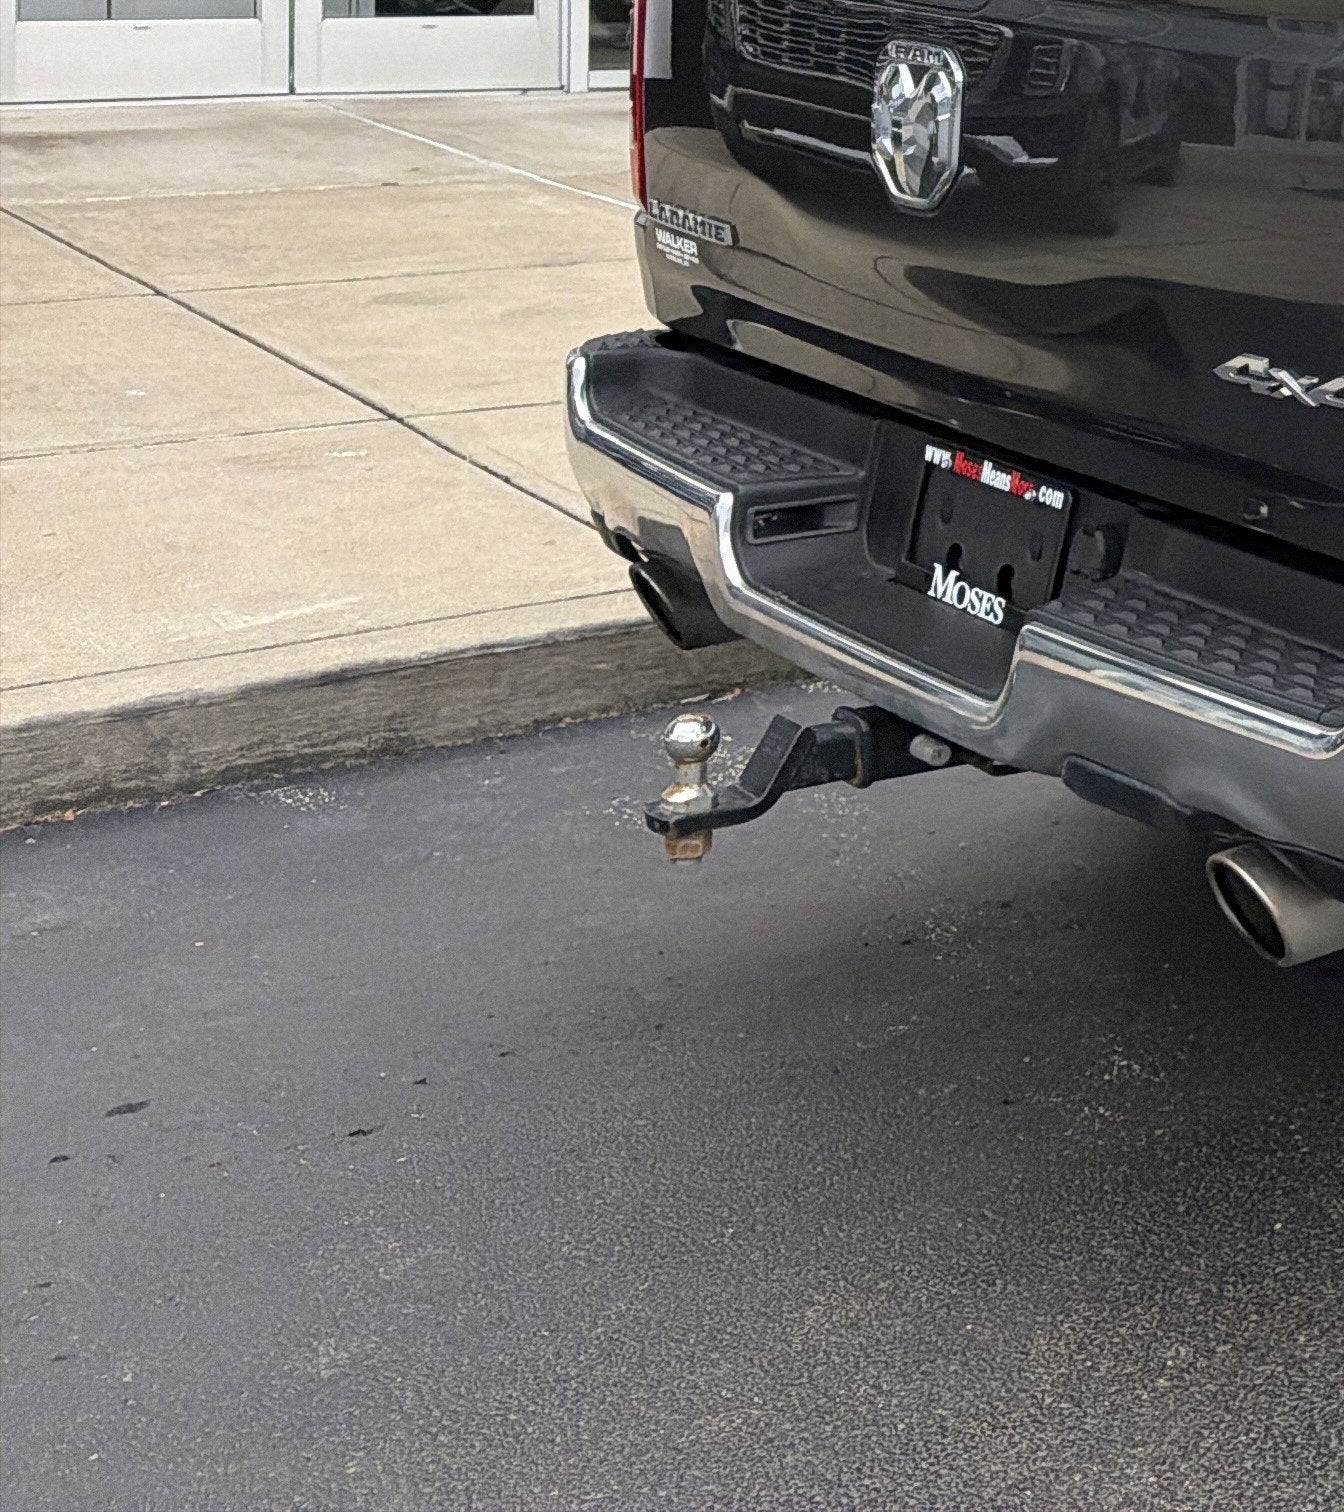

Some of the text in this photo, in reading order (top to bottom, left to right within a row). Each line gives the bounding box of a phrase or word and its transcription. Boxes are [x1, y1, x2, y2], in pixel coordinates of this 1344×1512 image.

[648, 197, 727, 244] LARAMIE
[654, 226, 698, 257] WALKER
[924, 444, 1065, 510] wwwMosesMeansMorecom
[927, 562, 1006, 625] MOSES
